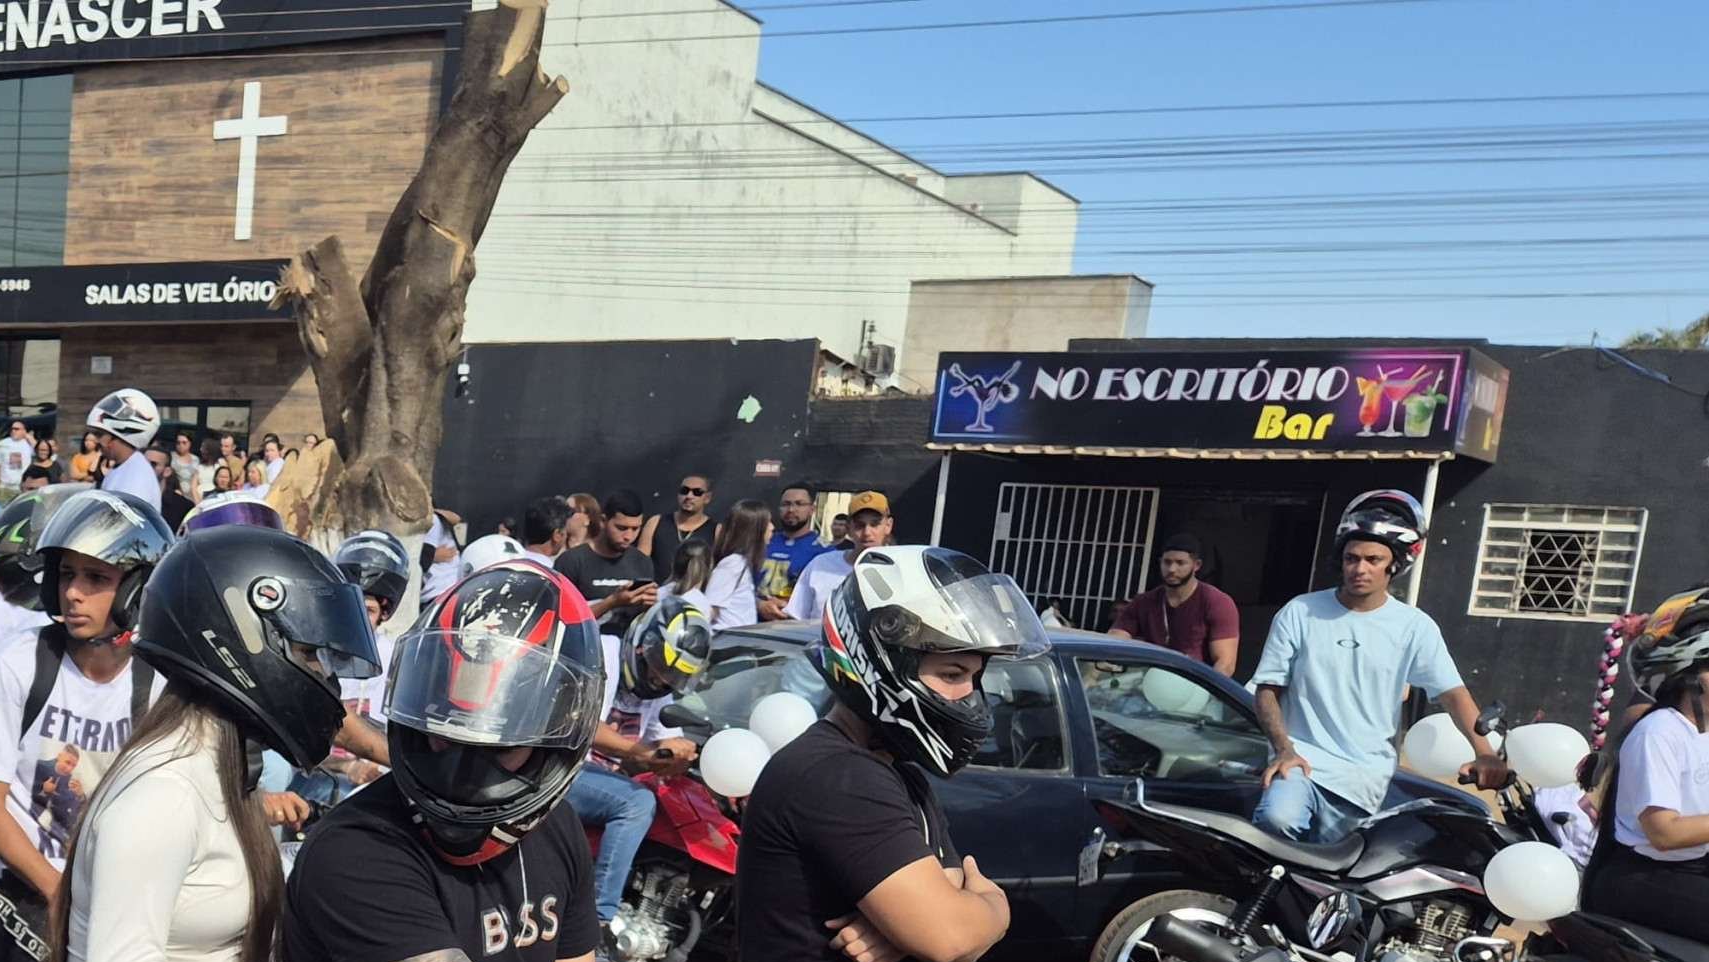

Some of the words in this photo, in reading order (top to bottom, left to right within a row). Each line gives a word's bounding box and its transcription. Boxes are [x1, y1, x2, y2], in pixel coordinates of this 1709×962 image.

[85, 284, 151, 305] SALAS
[153, 283, 181, 303] DE
[184, 276, 277, 303] VELÓRIO
[1029, 366, 1090, 400] NO
[1092, 359, 1350, 401] ESCRITÓRIO
[1252, 404, 1335, 440] Bar
[201, 629, 257, 690] LS2
[480, 895, 559, 956] BSS
